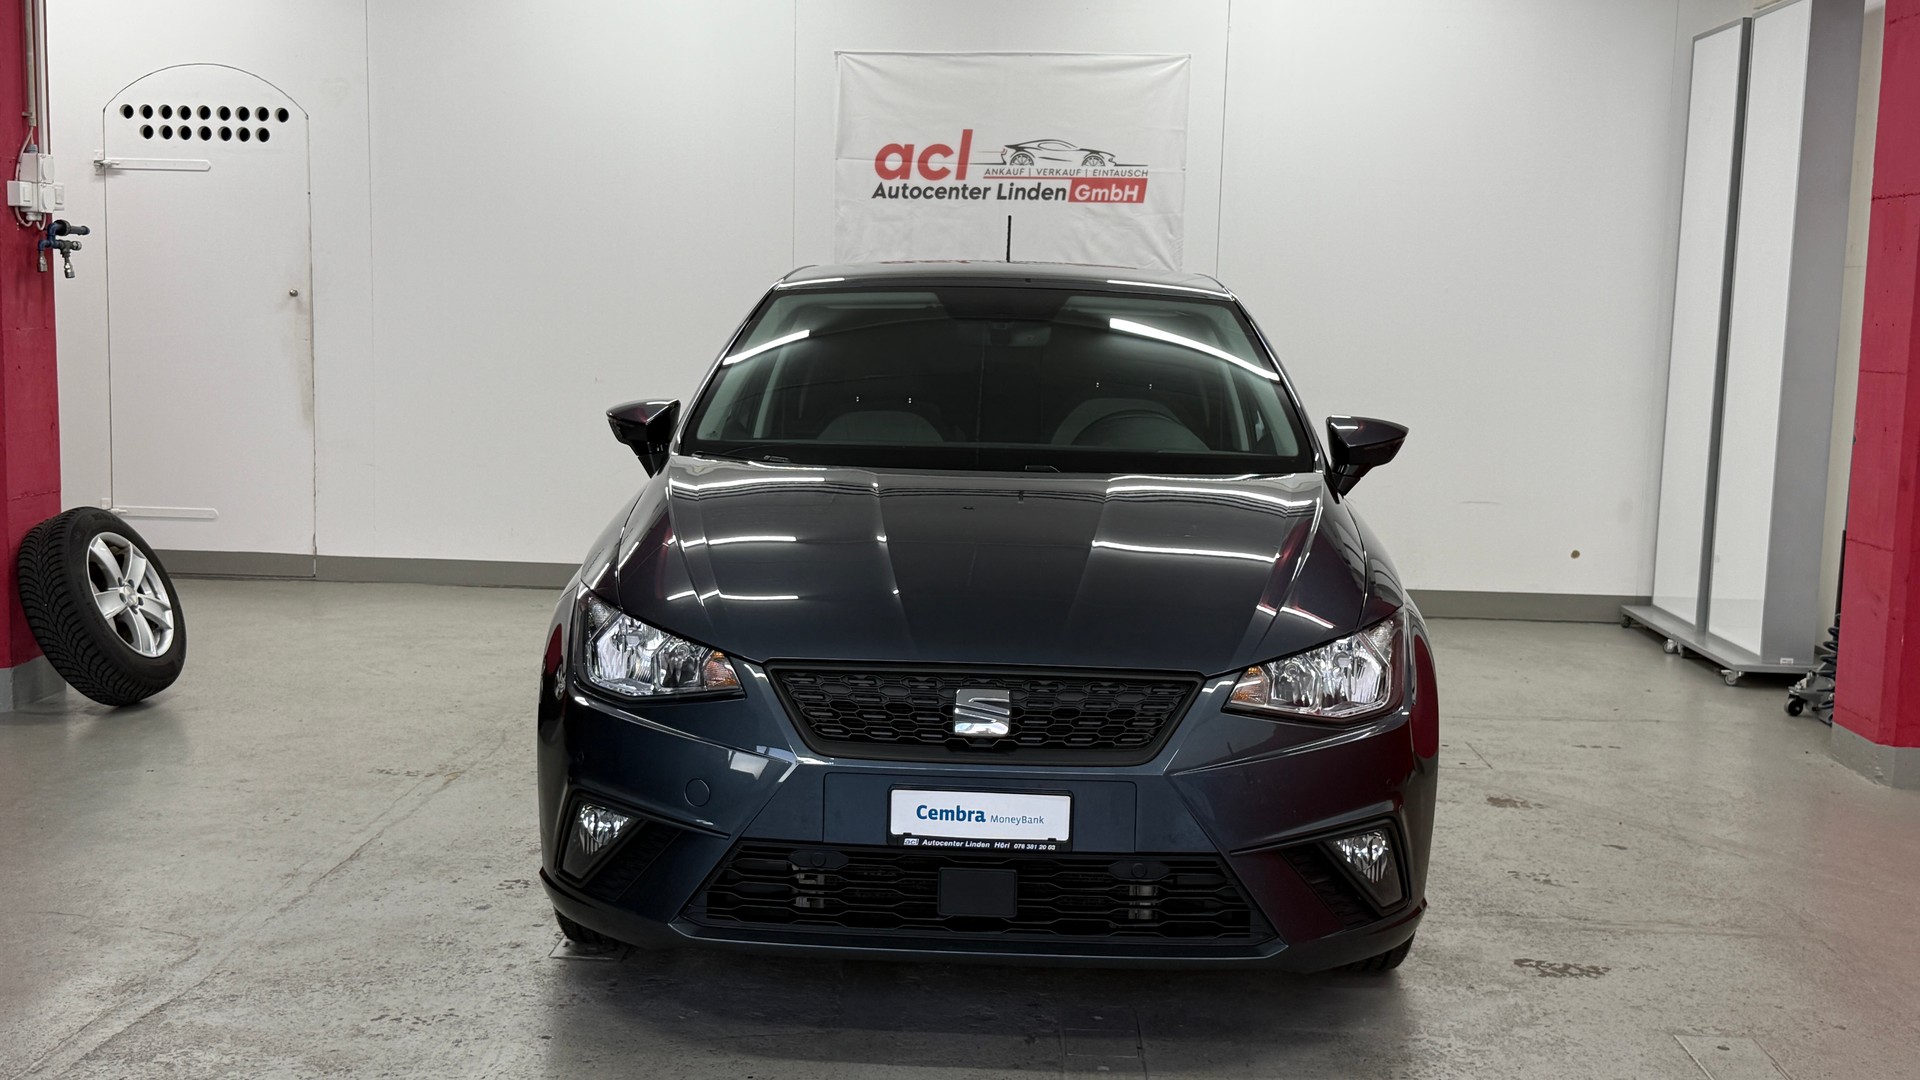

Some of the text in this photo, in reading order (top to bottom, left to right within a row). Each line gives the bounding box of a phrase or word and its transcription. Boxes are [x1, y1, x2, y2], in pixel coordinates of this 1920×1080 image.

[874, 129, 973, 181] acl
[984, 168, 1149, 177] ANKAUF VERKAUF EINTAUSCH
[871, 182, 1139, 202] Autocenter Linden GmbH
[916, 804, 1045, 826] Cembra MoneyBank
[921, 839, 964, 847] Autocenter
